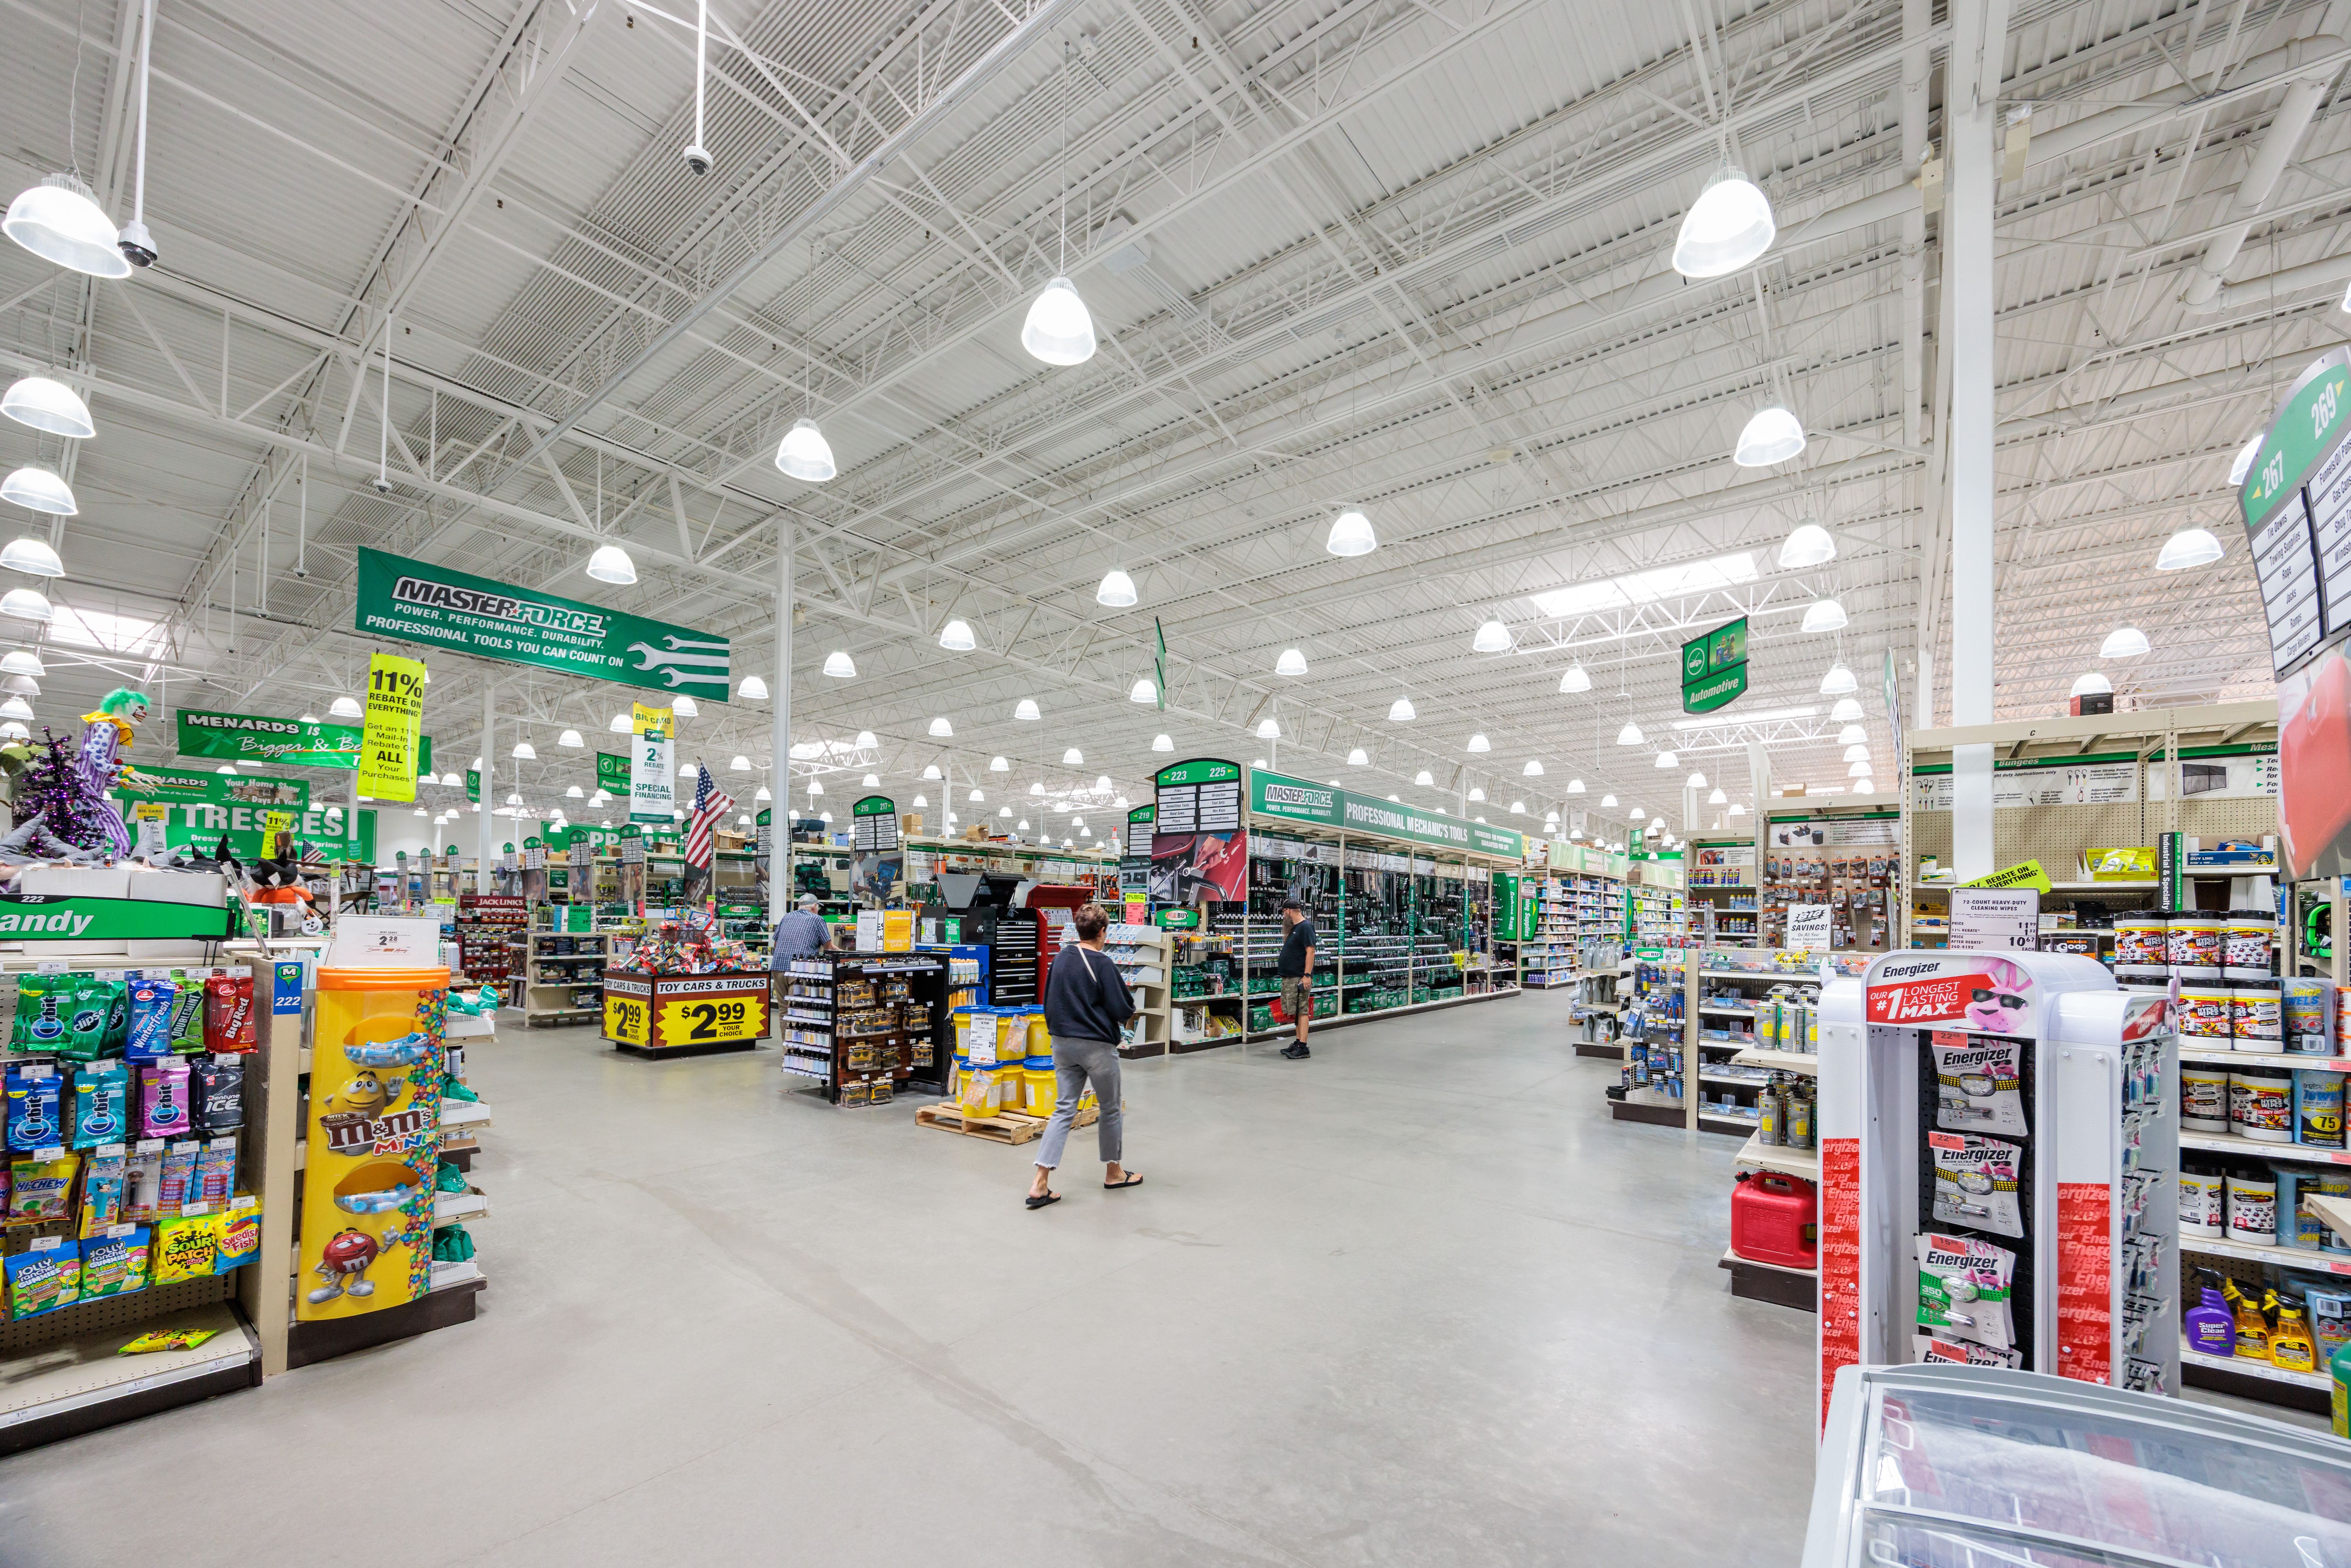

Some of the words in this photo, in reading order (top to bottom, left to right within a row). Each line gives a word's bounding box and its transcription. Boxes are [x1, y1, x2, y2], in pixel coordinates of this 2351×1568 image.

[2311, 381, 2337, 440] 269
[2262, 450, 2284, 500] 267
[2274, 514, 2287, 535] Downs
[2269, 548, 2284, 567] Towing
[2284, 531, 2300, 552] Supplies
[2282, 565, 2291, 581] Rope
[2286, 589, 2297, 605] Jacks
[394, 602, 442, 621] POWER.
[448, 614, 537, 638] PERFORMANCE.
[542, 630, 604, 649] DURABILITY.
[2290, 613, 2302, 629] Ramps
[366, 614, 468, 643] PROFESSIONAL
[473, 633, 513, 649] TOOLS
[516, 641, 538, 653] YOU
[542, 646, 566, 659] CAN
[569, 650, 606, 664] COUNT
[608, 656, 624, 668] ON
[2287, 641, 2297, 658] Cargo
[372, 669, 422, 699] 11%
[1689, 678, 1739, 704] Automotive
[369, 693, 408, 706] REBATE
[411, 700, 421, 709] ON
[186, 714, 300, 734] MENARDS
[307, 726, 321, 736] IS
[635, 713, 648, 722] BIG
[376, 732, 408, 743] Mail-In
[400, 728, 417, 737] 11%
[236, 736, 306, 758] Bigger
[313, 739, 330, 752] &
[367, 739, 401, 750] Rebate
[404, 744, 415, 752] On
[376, 750, 403, 764] ALL
[646, 747, 663, 762] 2%
[377, 764, 400, 772] Your
[1998, 758, 2039, 767] Bungees
[1171, 771, 1187, 781] 223
[1209, 767, 1226, 777] 225
[224, 778, 245, 787] Your
[249, 779, 274, 789] Home
[278, 782, 301, 793] Show
[602, 780, 620, 790] Power
[636, 783, 671, 793] SPECIAL
[220, 793, 248, 802] 362
[251, 796, 271, 805] Days
[635, 792, 672, 800] FINANCING
[1346, 802, 1405, 830] PROFESSIONAL
[1407, 816, 1448, 837] MECHANIC'S
[1449, 824, 1468, 842] TOOLS
[1475, 830, 1490, 839] ENGINEERED
[1497, 834, 1514, 844] PERFORMANCE
[1482, 840, 1498, 848] GUARANTEED
[1985, 871, 2014, 885] REBATE
[2015, 865, 2030, 876] ON
[2161, 876, 2170, 911] Specialty
[1795, 910, 1826, 922] BIG
[1882, 962, 1940, 978] Energizer
[659, 984, 680, 993] TOY
[683, 982, 712, 991] CARS
[715, 981, 723, 989] &
[726, 979, 765, 989] TRUCKS
[1904, 981, 1961, 996] LONGEST
[274, 996, 301, 1007] 222
[1870, 991, 1887, 1000] OUR
[1903, 991, 1958, 1006] LASTING
[172, 993, 201, 1039] DOUBLEMINT
[132, 1000, 171, 1049] Winterfresh
[1943, 1048, 2012, 1066] Energizer
[207, 1093, 240, 1102] Dentyne
[205, 1099, 238, 1113] ICE
[2320, 1116, 2335, 1128] 75
[16, 1177, 69, 1191] HI-CHEW
[168, 1236, 213, 1254] SOUR
[231, 1238, 256, 1253] Fish
[166, 1246, 215, 1265] PATCH
[186, 1257, 205, 1265] Kids
[1926, 1251, 1998, 1270] Energizer
